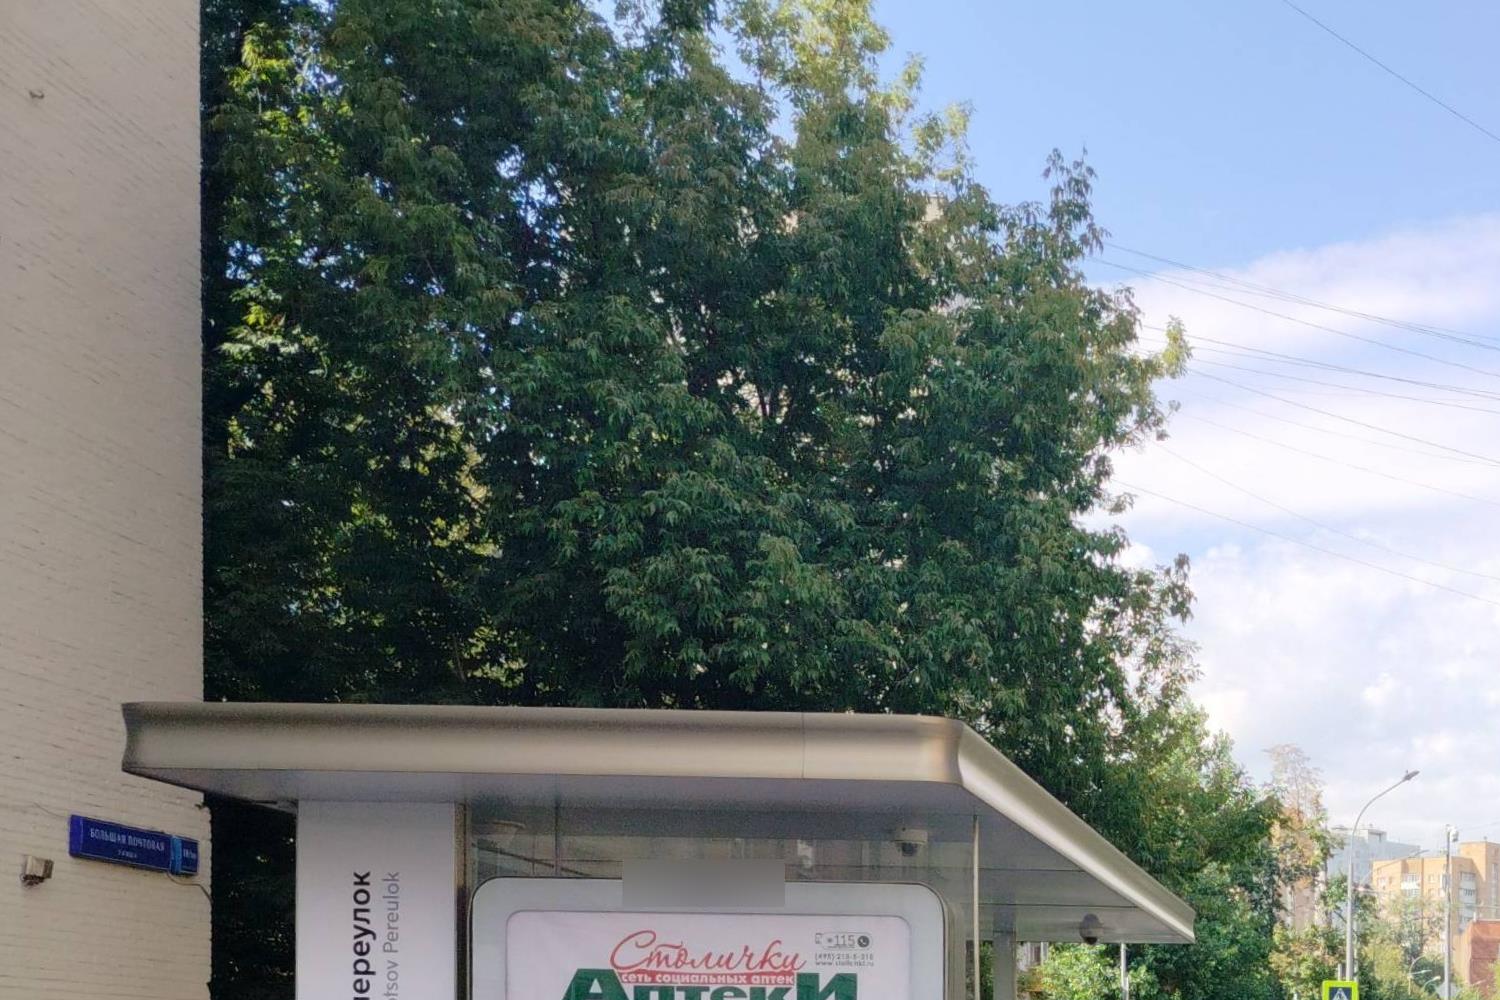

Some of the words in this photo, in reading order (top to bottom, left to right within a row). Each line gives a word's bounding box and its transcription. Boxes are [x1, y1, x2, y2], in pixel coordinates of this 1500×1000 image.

[90, 828, 127, 844] БОЛЬШАЯ
[128, 835, 165, 851] ПОЧТОВАЯ
[382, 871, 400, 953] Pereulok
[609, 929, 807, 973] Столички
[622, 974, 652, 984] сеть
[656, 974, 746, 985] социальных
[752, 974, 794, 984] аптек
